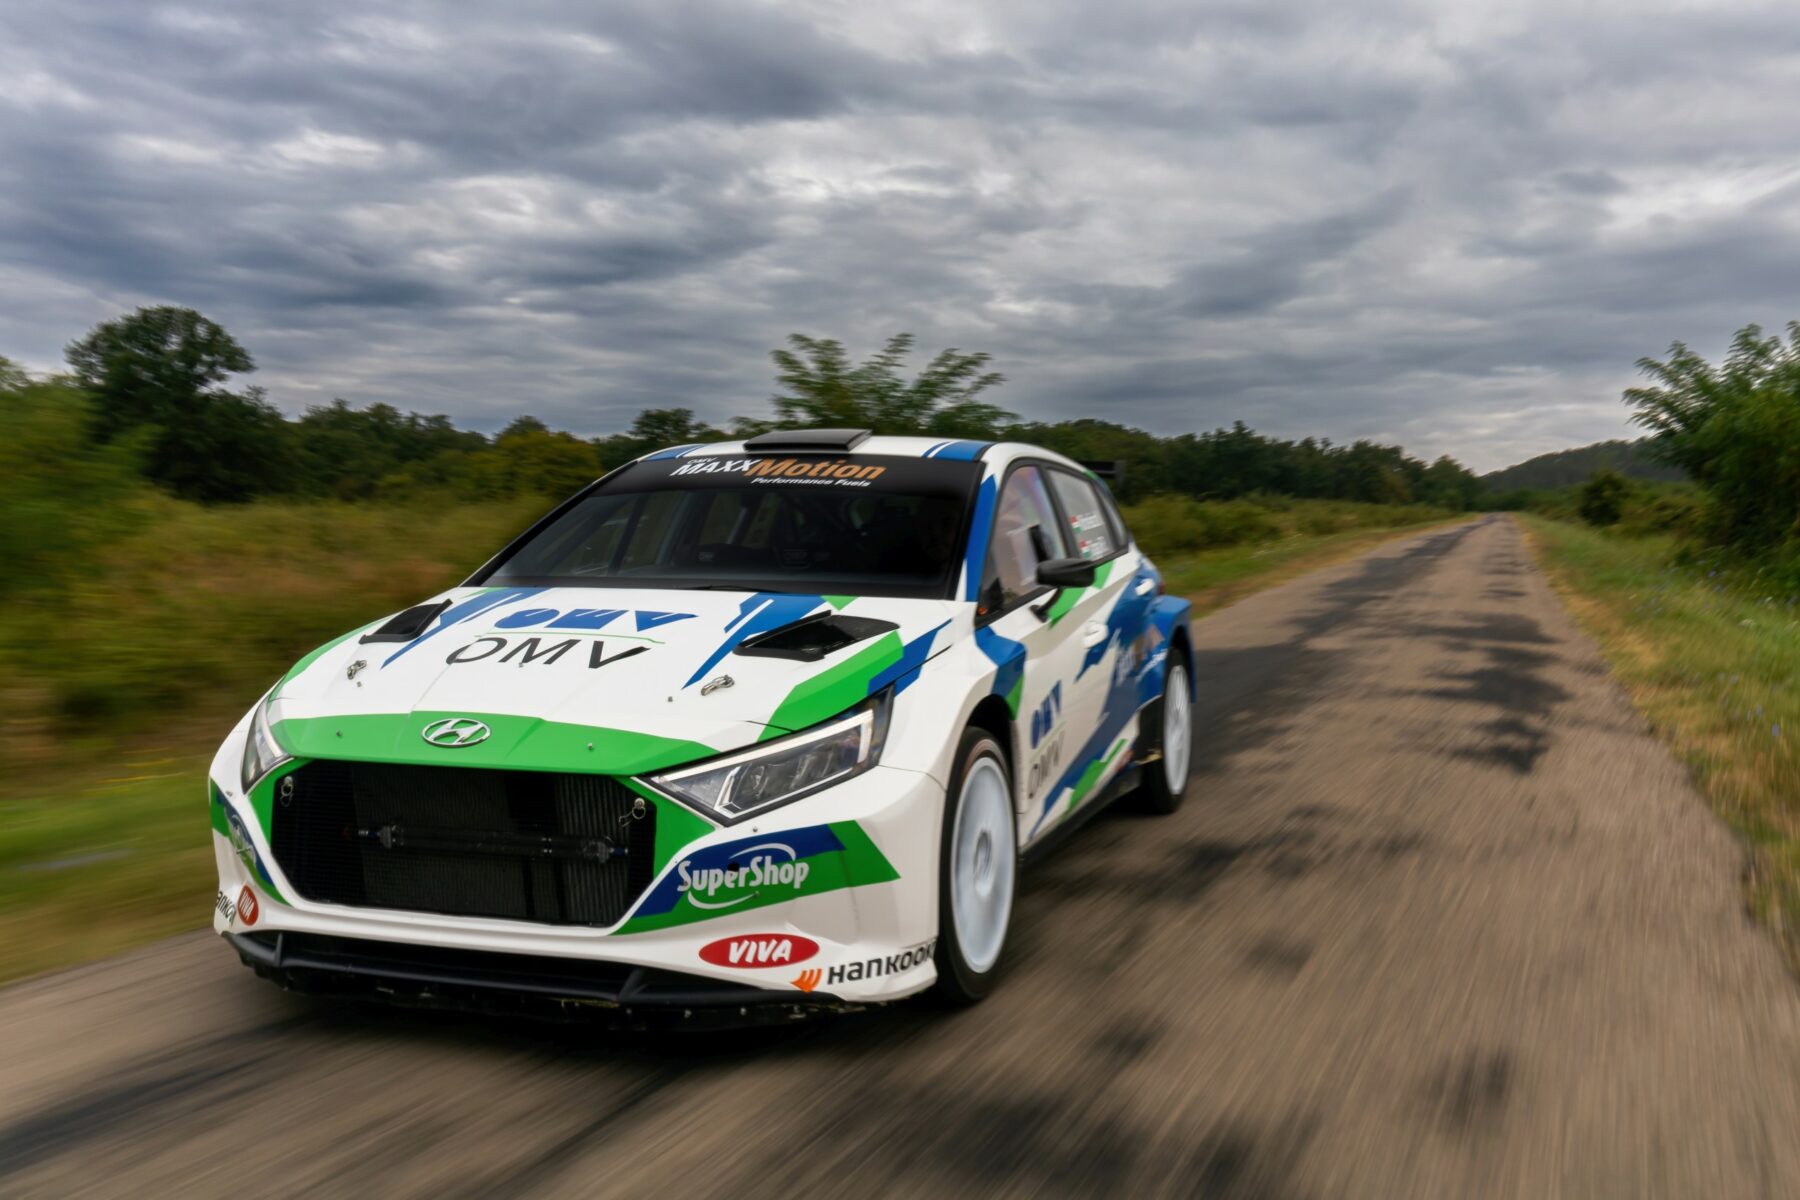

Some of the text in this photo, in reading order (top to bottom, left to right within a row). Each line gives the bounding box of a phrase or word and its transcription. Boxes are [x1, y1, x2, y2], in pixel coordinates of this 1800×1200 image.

[750, 477, 872, 487] Performance Fuels
[445, 637, 652, 669] OMV
[677, 855, 810, 896] SuperShop
[728, 939, 793, 964] VIVA
